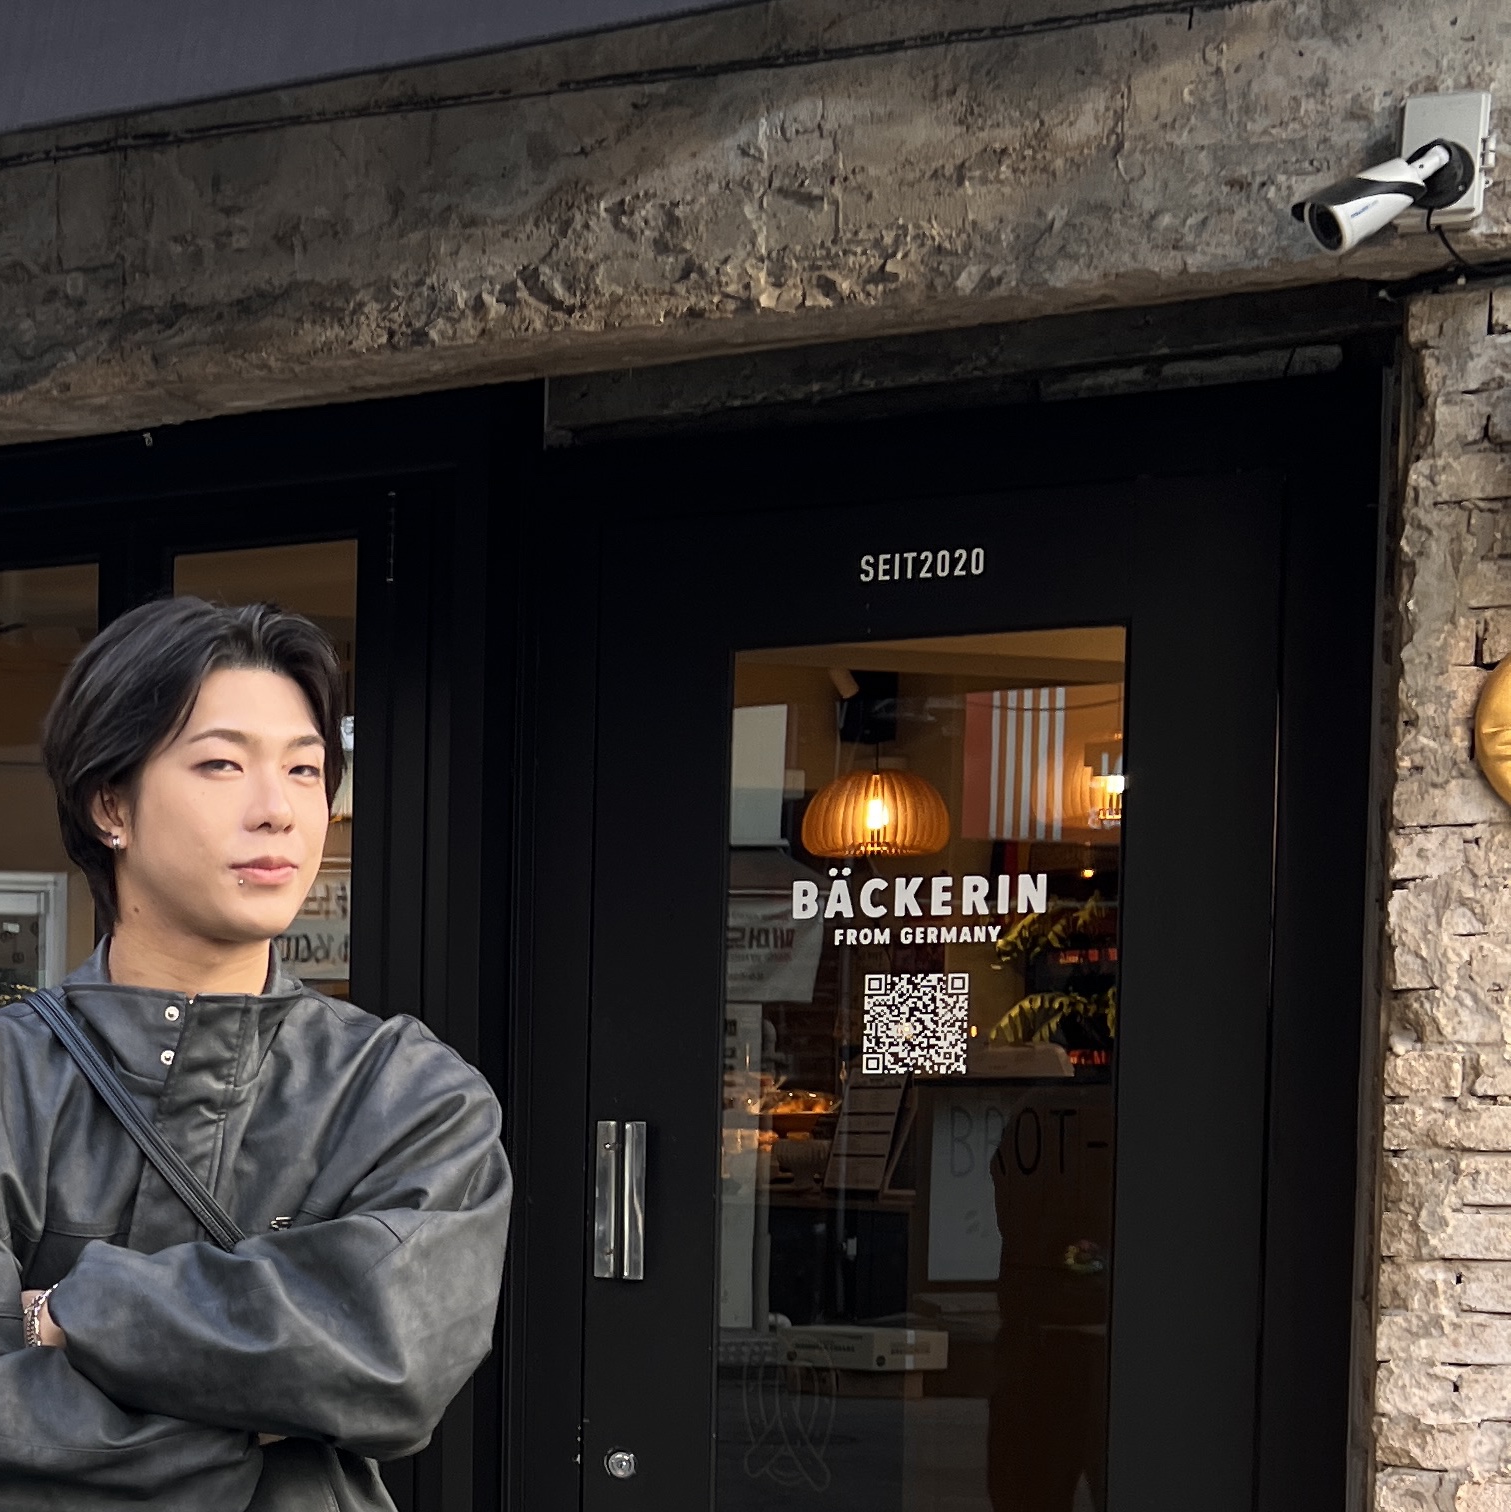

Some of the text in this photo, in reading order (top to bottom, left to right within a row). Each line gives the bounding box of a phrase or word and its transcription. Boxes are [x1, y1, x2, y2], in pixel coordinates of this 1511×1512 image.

[859, 547, 985, 582] SEIT2020
[792, 867, 1048, 919] BÄCKERIN
[834, 926, 1002, 946] FROM GERMANY
